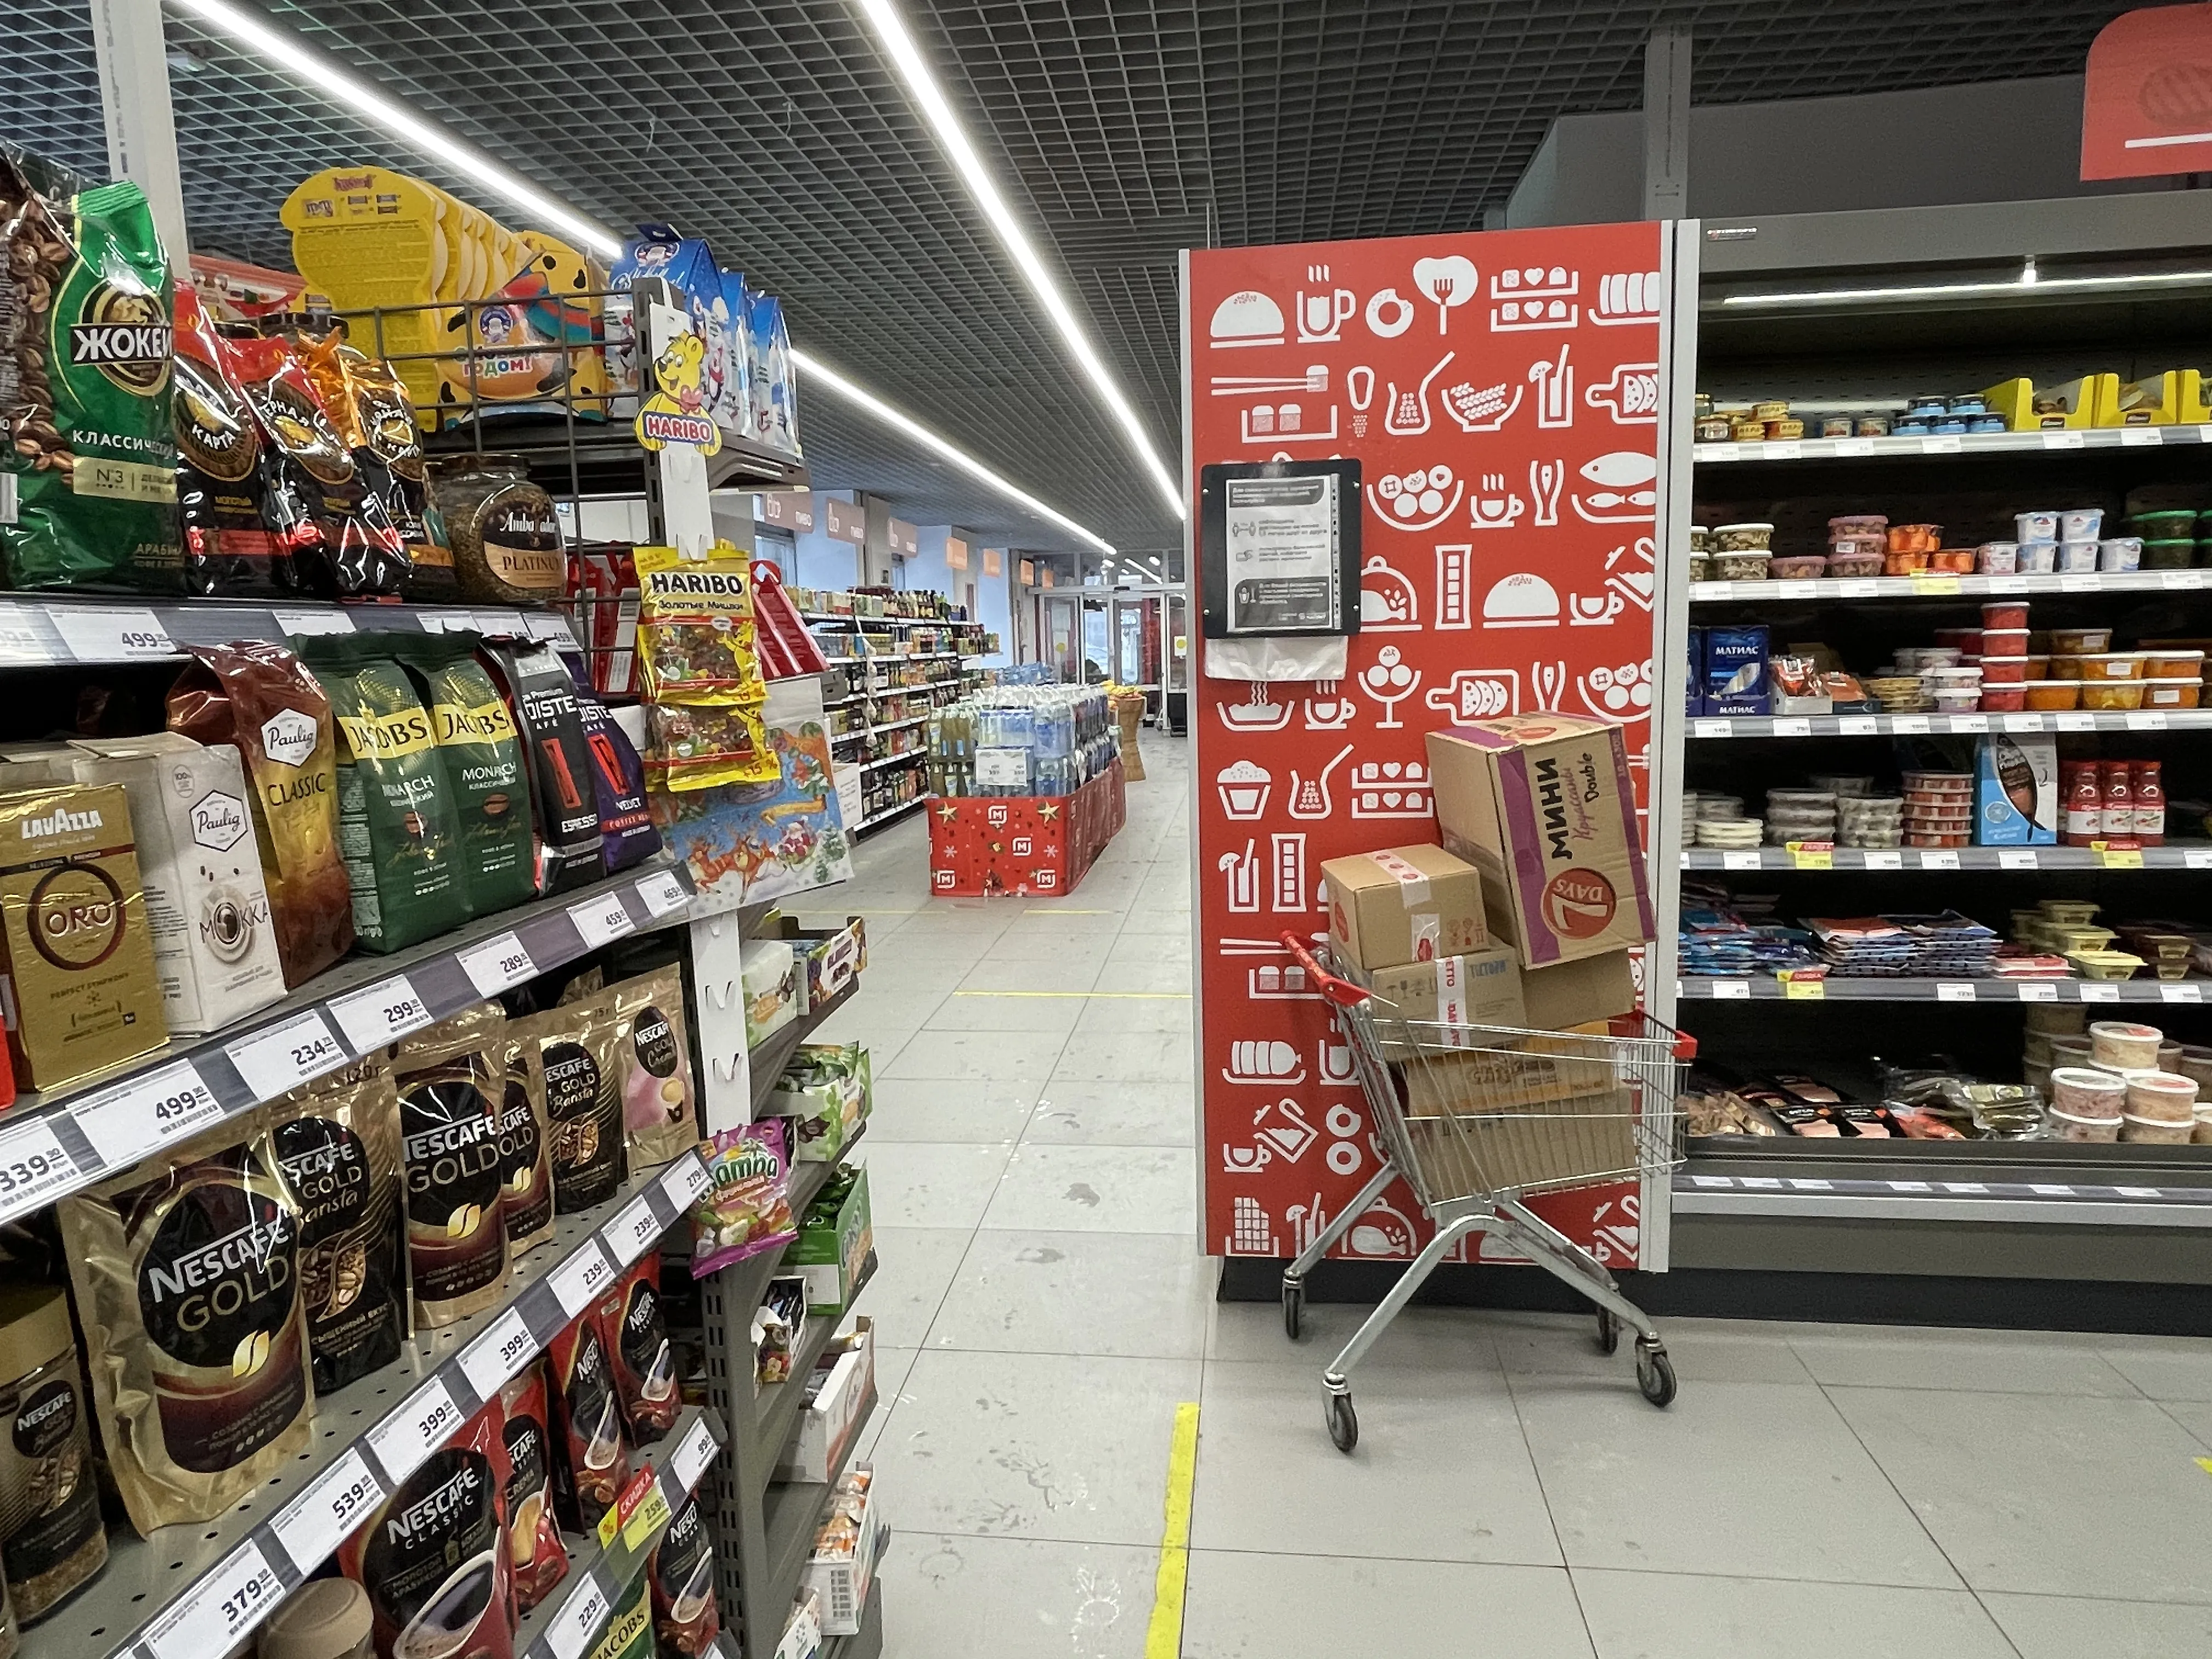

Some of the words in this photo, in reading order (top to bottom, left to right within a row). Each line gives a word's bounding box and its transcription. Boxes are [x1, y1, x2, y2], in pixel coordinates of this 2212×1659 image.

[646, 416, 711, 442] HARIBO
[650, 573, 743, 595] HARIBO
[658, 601, 704, 610] Золотые
[122, 632, 156, 648] 499
[268, 725, 314, 750] Paulig
[349, 716, 427, 752] JACOBS
[442, 709, 510, 739] JACOBS
[267, 772, 326, 807] CLASSIC
[1577, 752, 1600, 803] Double
[196, 808, 240, 834] Paulig
[1535, 757, 1573, 860] МИНИ
[21, 808, 104, 840] LAVAZZA
[1554, 879, 1603, 902] DAYS
[45, 901, 114, 938] ORO
[1551, 893, 1608, 931] 7
[500, 955, 523, 973] 289
[383, 1002, 414, 1023] 299
[291, 1040, 327, 1066] 234
[561, 1073, 596, 1094] GOLD
[155, 1091, 197, 1120] 499
[500, 1127, 533, 1156] OLD
[0, 1155, 50, 1193] 339
[302, 1166, 363, 1199] GOLD
[407, 1143, 499, 1193] GOLD
[305, 1188, 358, 1223] arista
[634, 1219, 652, 1238] 239
[583, 1262, 602, 1285] 239
[177, 1255, 289, 1332] GOLD
[500, 1334, 524, 1362] 399
[419, 1406, 448, 1438] 399
[331, 1484, 365, 1520] 539
[619, 1470, 653, 1515] СКИДКА
[405, 1498, 473, 1549] CLASSIC
[220, 1579, 263, 1622] 379
[578, 1598, 597, 1628] 229
